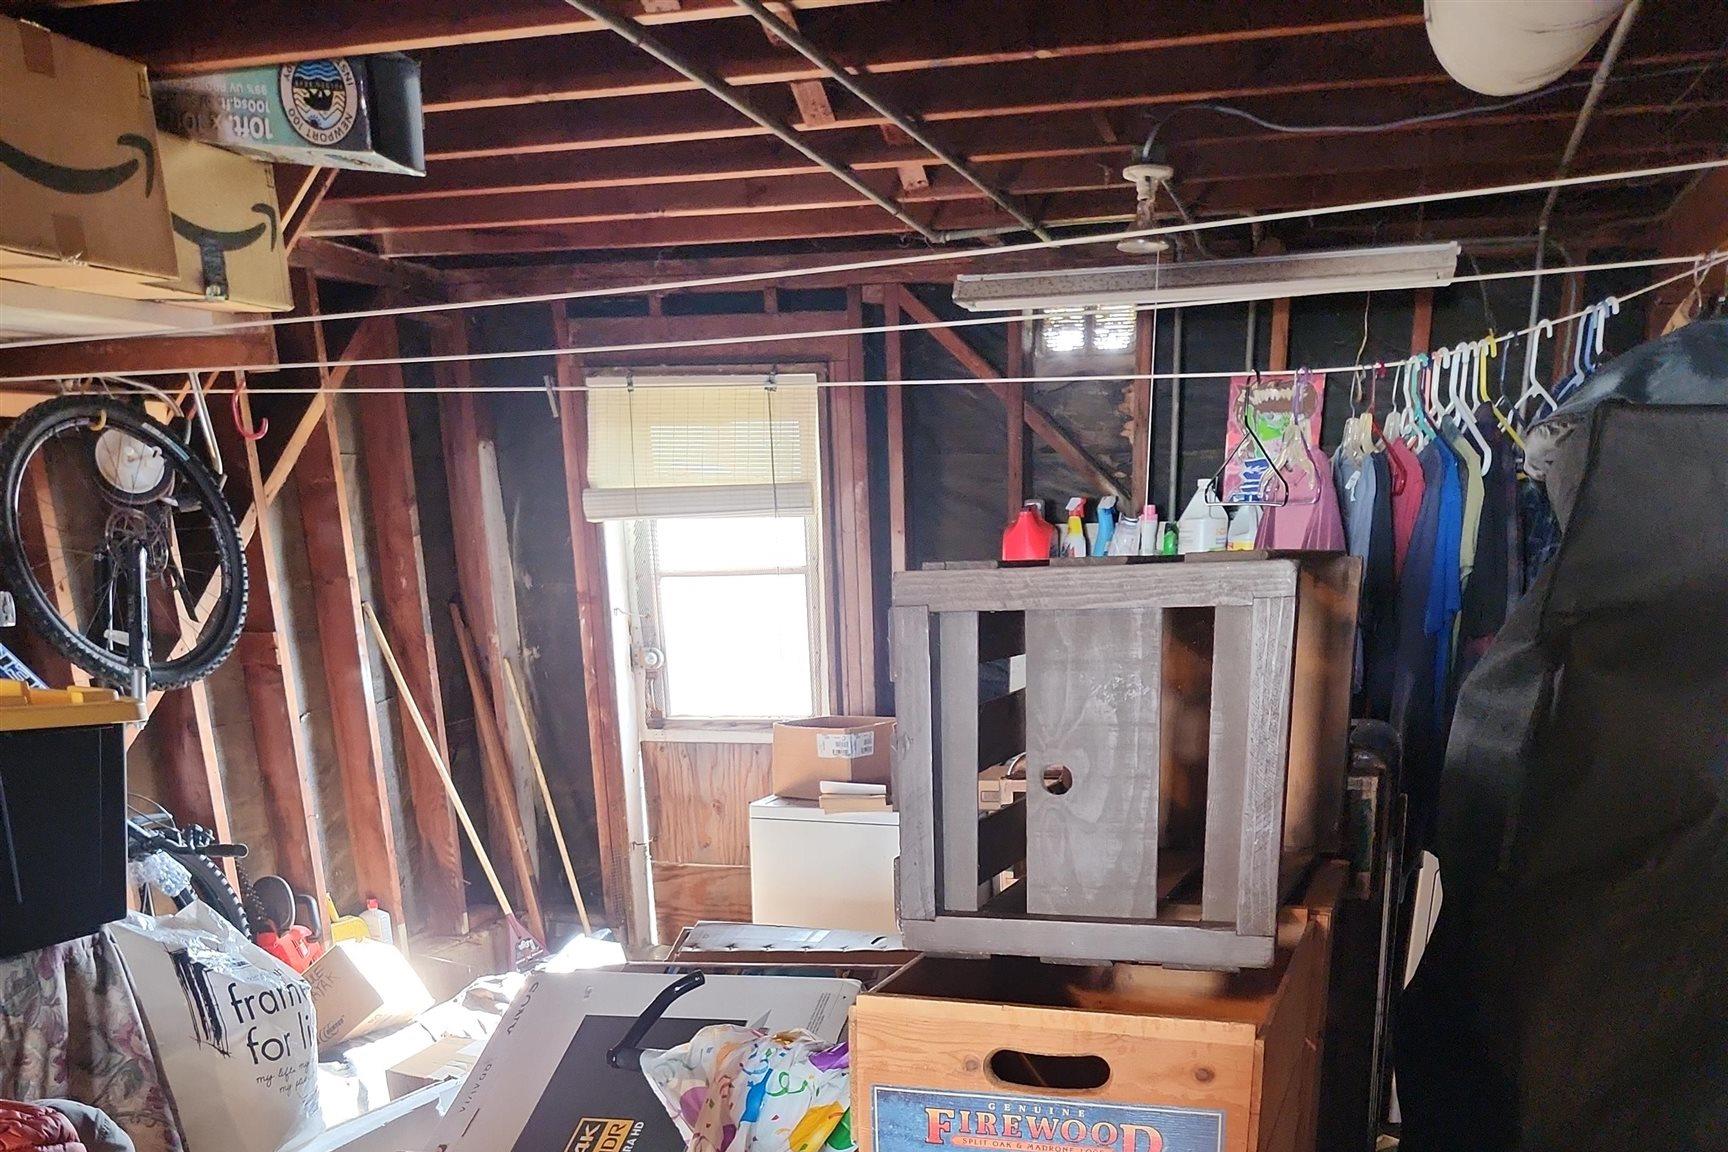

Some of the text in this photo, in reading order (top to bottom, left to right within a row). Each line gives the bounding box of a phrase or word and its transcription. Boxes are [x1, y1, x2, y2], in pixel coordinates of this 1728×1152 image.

[305, 112, 353, 143] NEWPORT
[246, 1026, 291, 1065] for
[297, 1011, 313, 1050] li
[987, 1101, 1086, 1119] GENUINE
[631, 1121, 645, 1137] HD
[961, 1137, 989, 1147] SPLIT
[992, 1140, 1013, 1149] OAK
